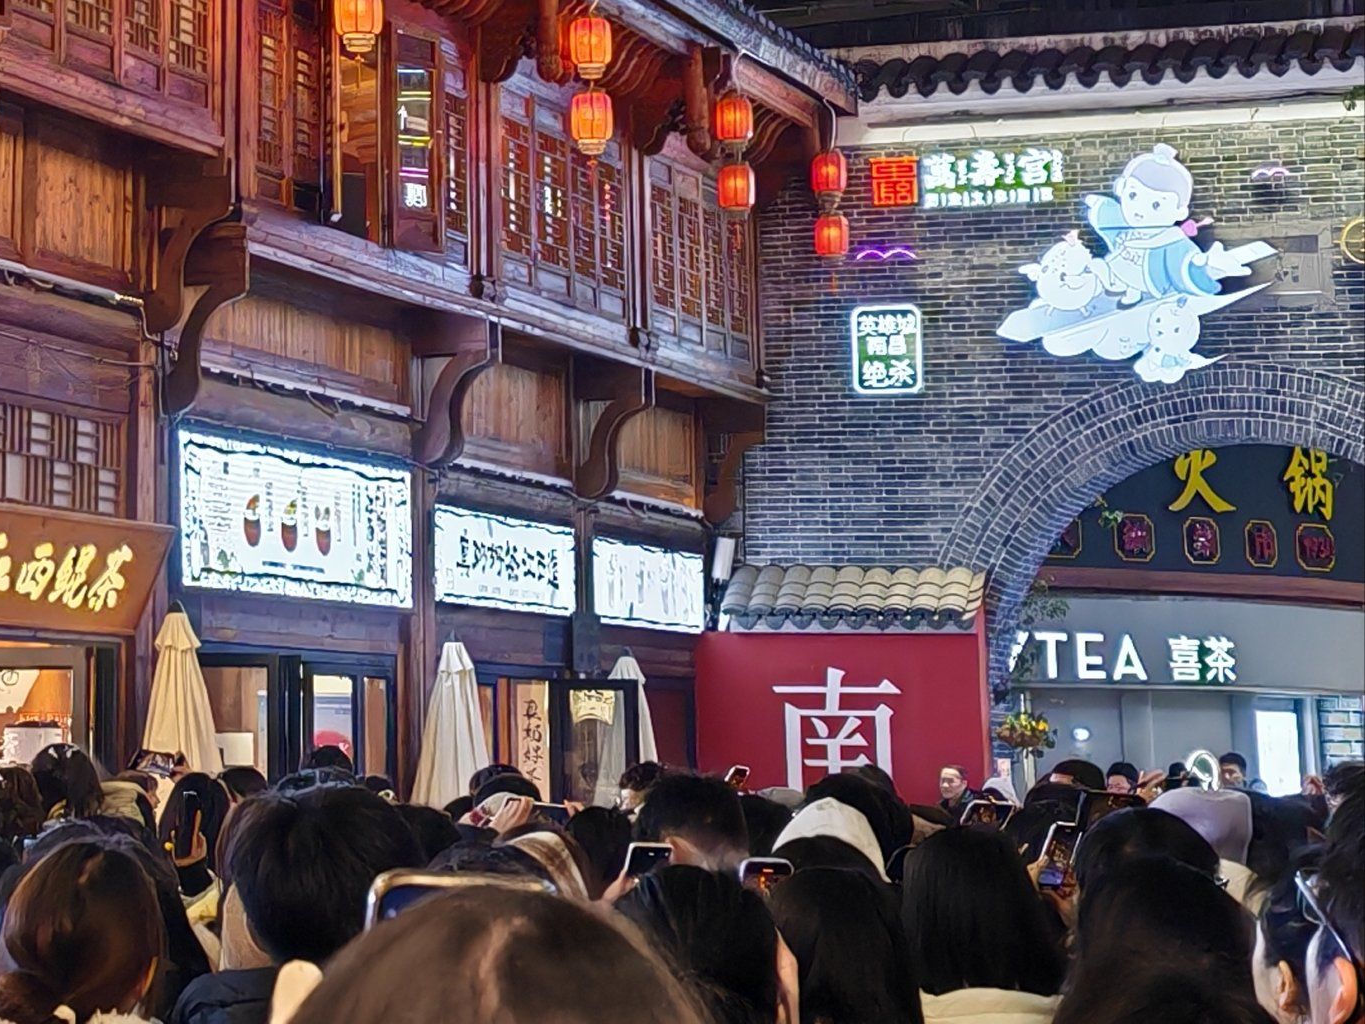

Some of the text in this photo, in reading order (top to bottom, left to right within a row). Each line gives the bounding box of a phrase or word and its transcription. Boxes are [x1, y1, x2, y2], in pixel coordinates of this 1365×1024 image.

[1169, 446, 1334, 521] 火锅
[1168, 635, 1237, 683] 喜茶
[772, 666, 902, 794] 南
